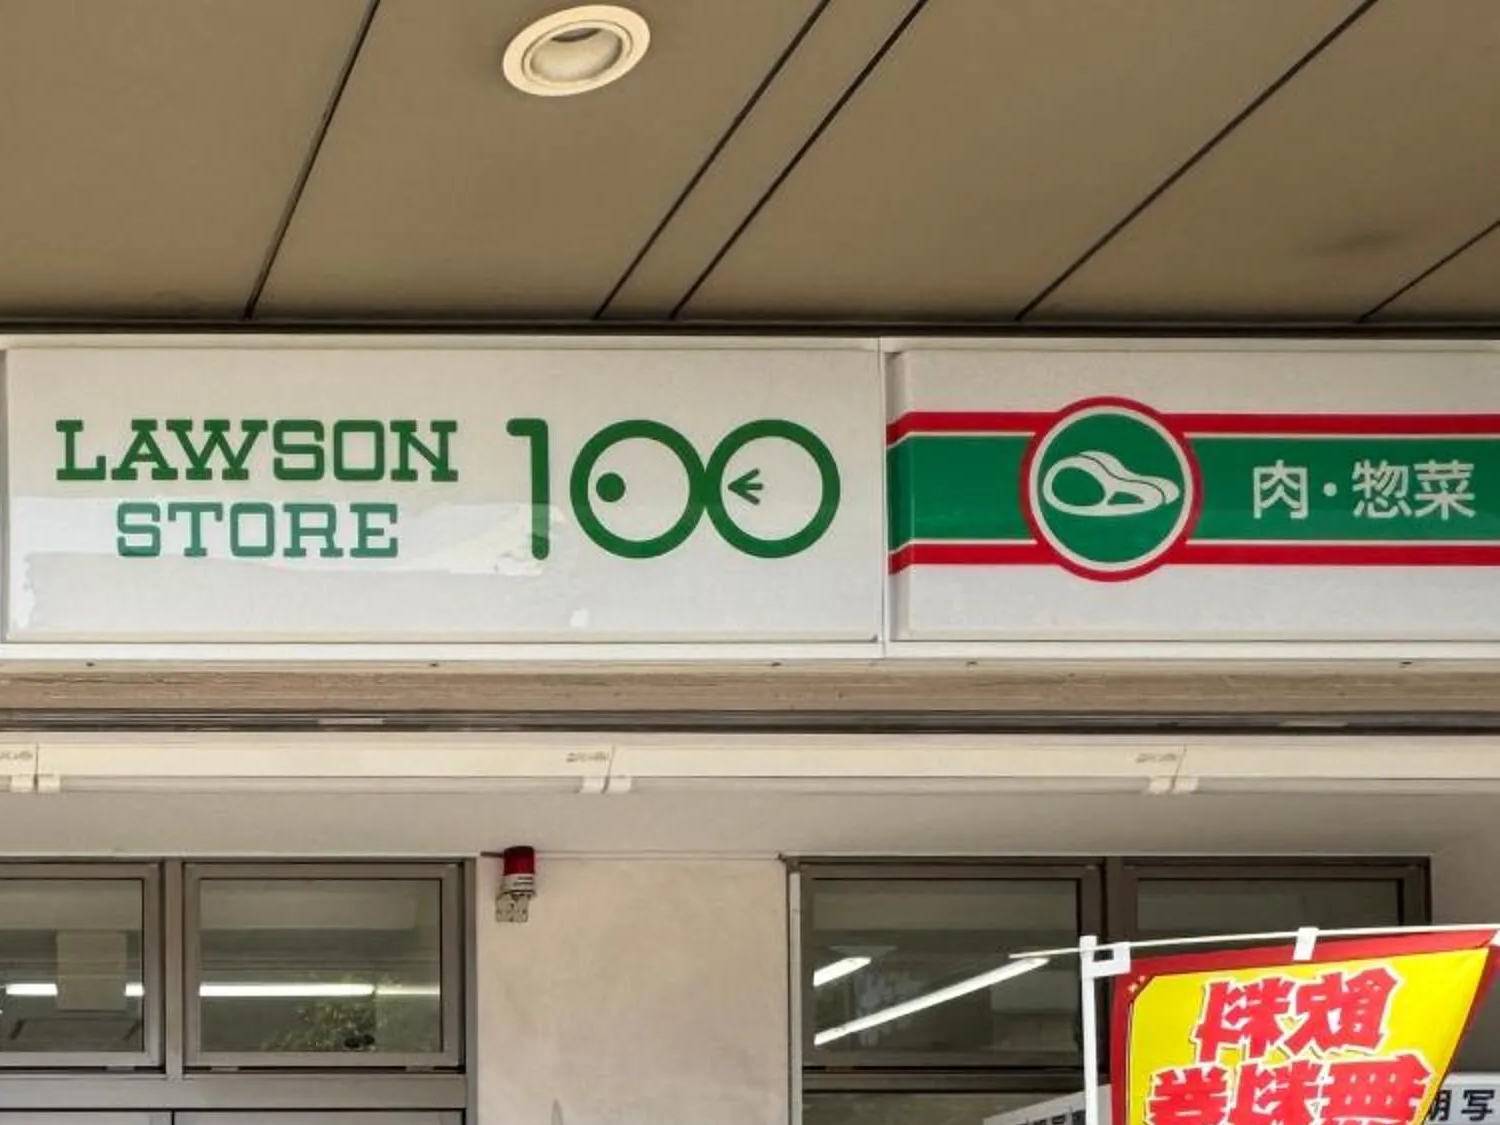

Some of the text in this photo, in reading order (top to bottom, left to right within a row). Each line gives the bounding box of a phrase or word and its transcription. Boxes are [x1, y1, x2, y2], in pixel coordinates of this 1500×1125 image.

[56, 419, 459, 482] LAWSON
[506, 418, 841, 560] 100
[1253, 459, 1476, 520] 肉・惣菜
[116, 503, 399, 558] STORE
